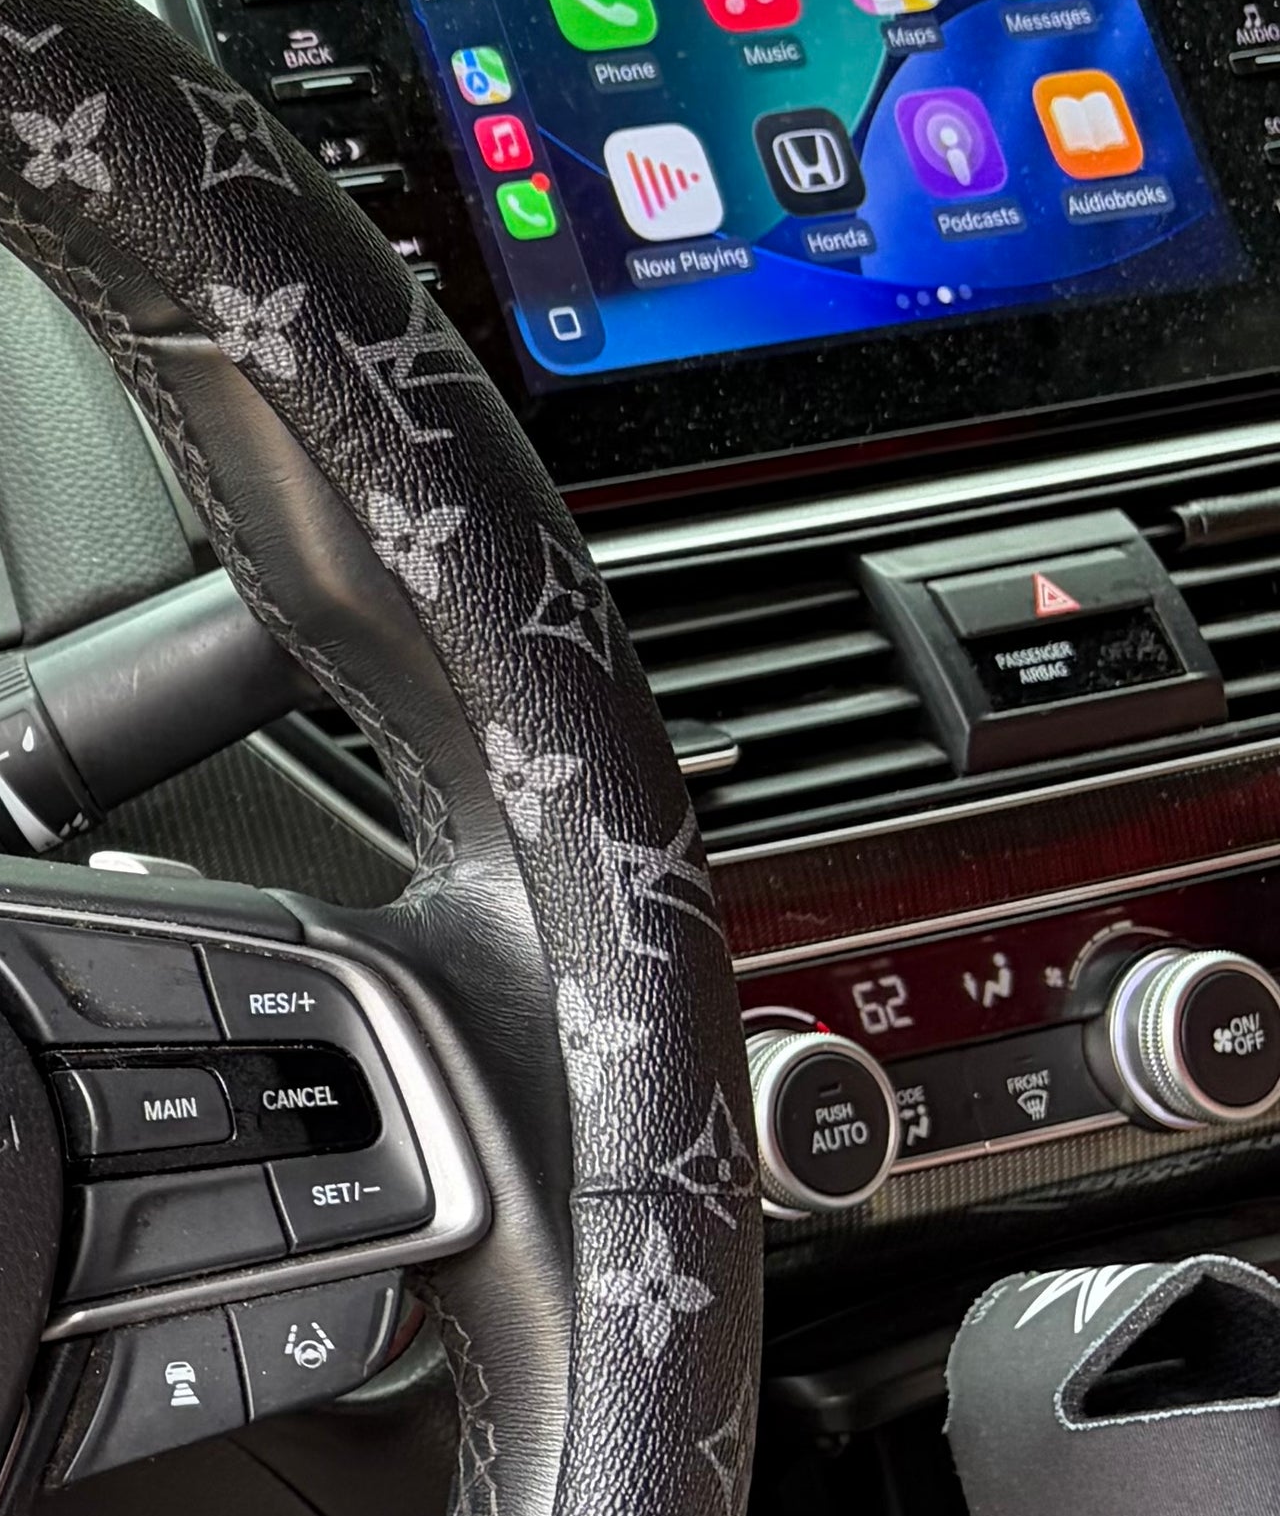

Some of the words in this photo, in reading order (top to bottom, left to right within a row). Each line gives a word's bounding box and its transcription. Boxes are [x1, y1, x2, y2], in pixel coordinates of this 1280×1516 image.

[1005, 7, 1092, 33] Messages
[887, 27, 938, 49] Maps
[1236, 22, 1280, 46] AUDIO
[283, 46, 334, 68] BACK
[743, 40, 801, 66] Music
[594, 61, 657, 84] Phone
[1068, 184, 1168, 216] Audiobooks
[938, 206, 1021, 234] Podcasts
[807, 227, 869, 253] Honda
[633, 256, 678, 280] Now
[680, 245, 750, 274] Playing
[994, 640, 1076, 671] PASSENGER
[1019, 660, 1071, 685] AIRBAG
[248, 990, 317, 1016] RES/+
[852, 974, 915, 1035] 62
[1234, 1029, 1265, 1056] OFF
[1006, 1069, 1050, 1094] FRONT
[261, 1085, 339, 1112] CANCEL
[895, 1085, 926, 1106] ODE
[143, 1096, 199, 1123] MAIN
[815, 1101, 854, 1124] PUSH
[811, 1120, 869, 1155] AUTO
